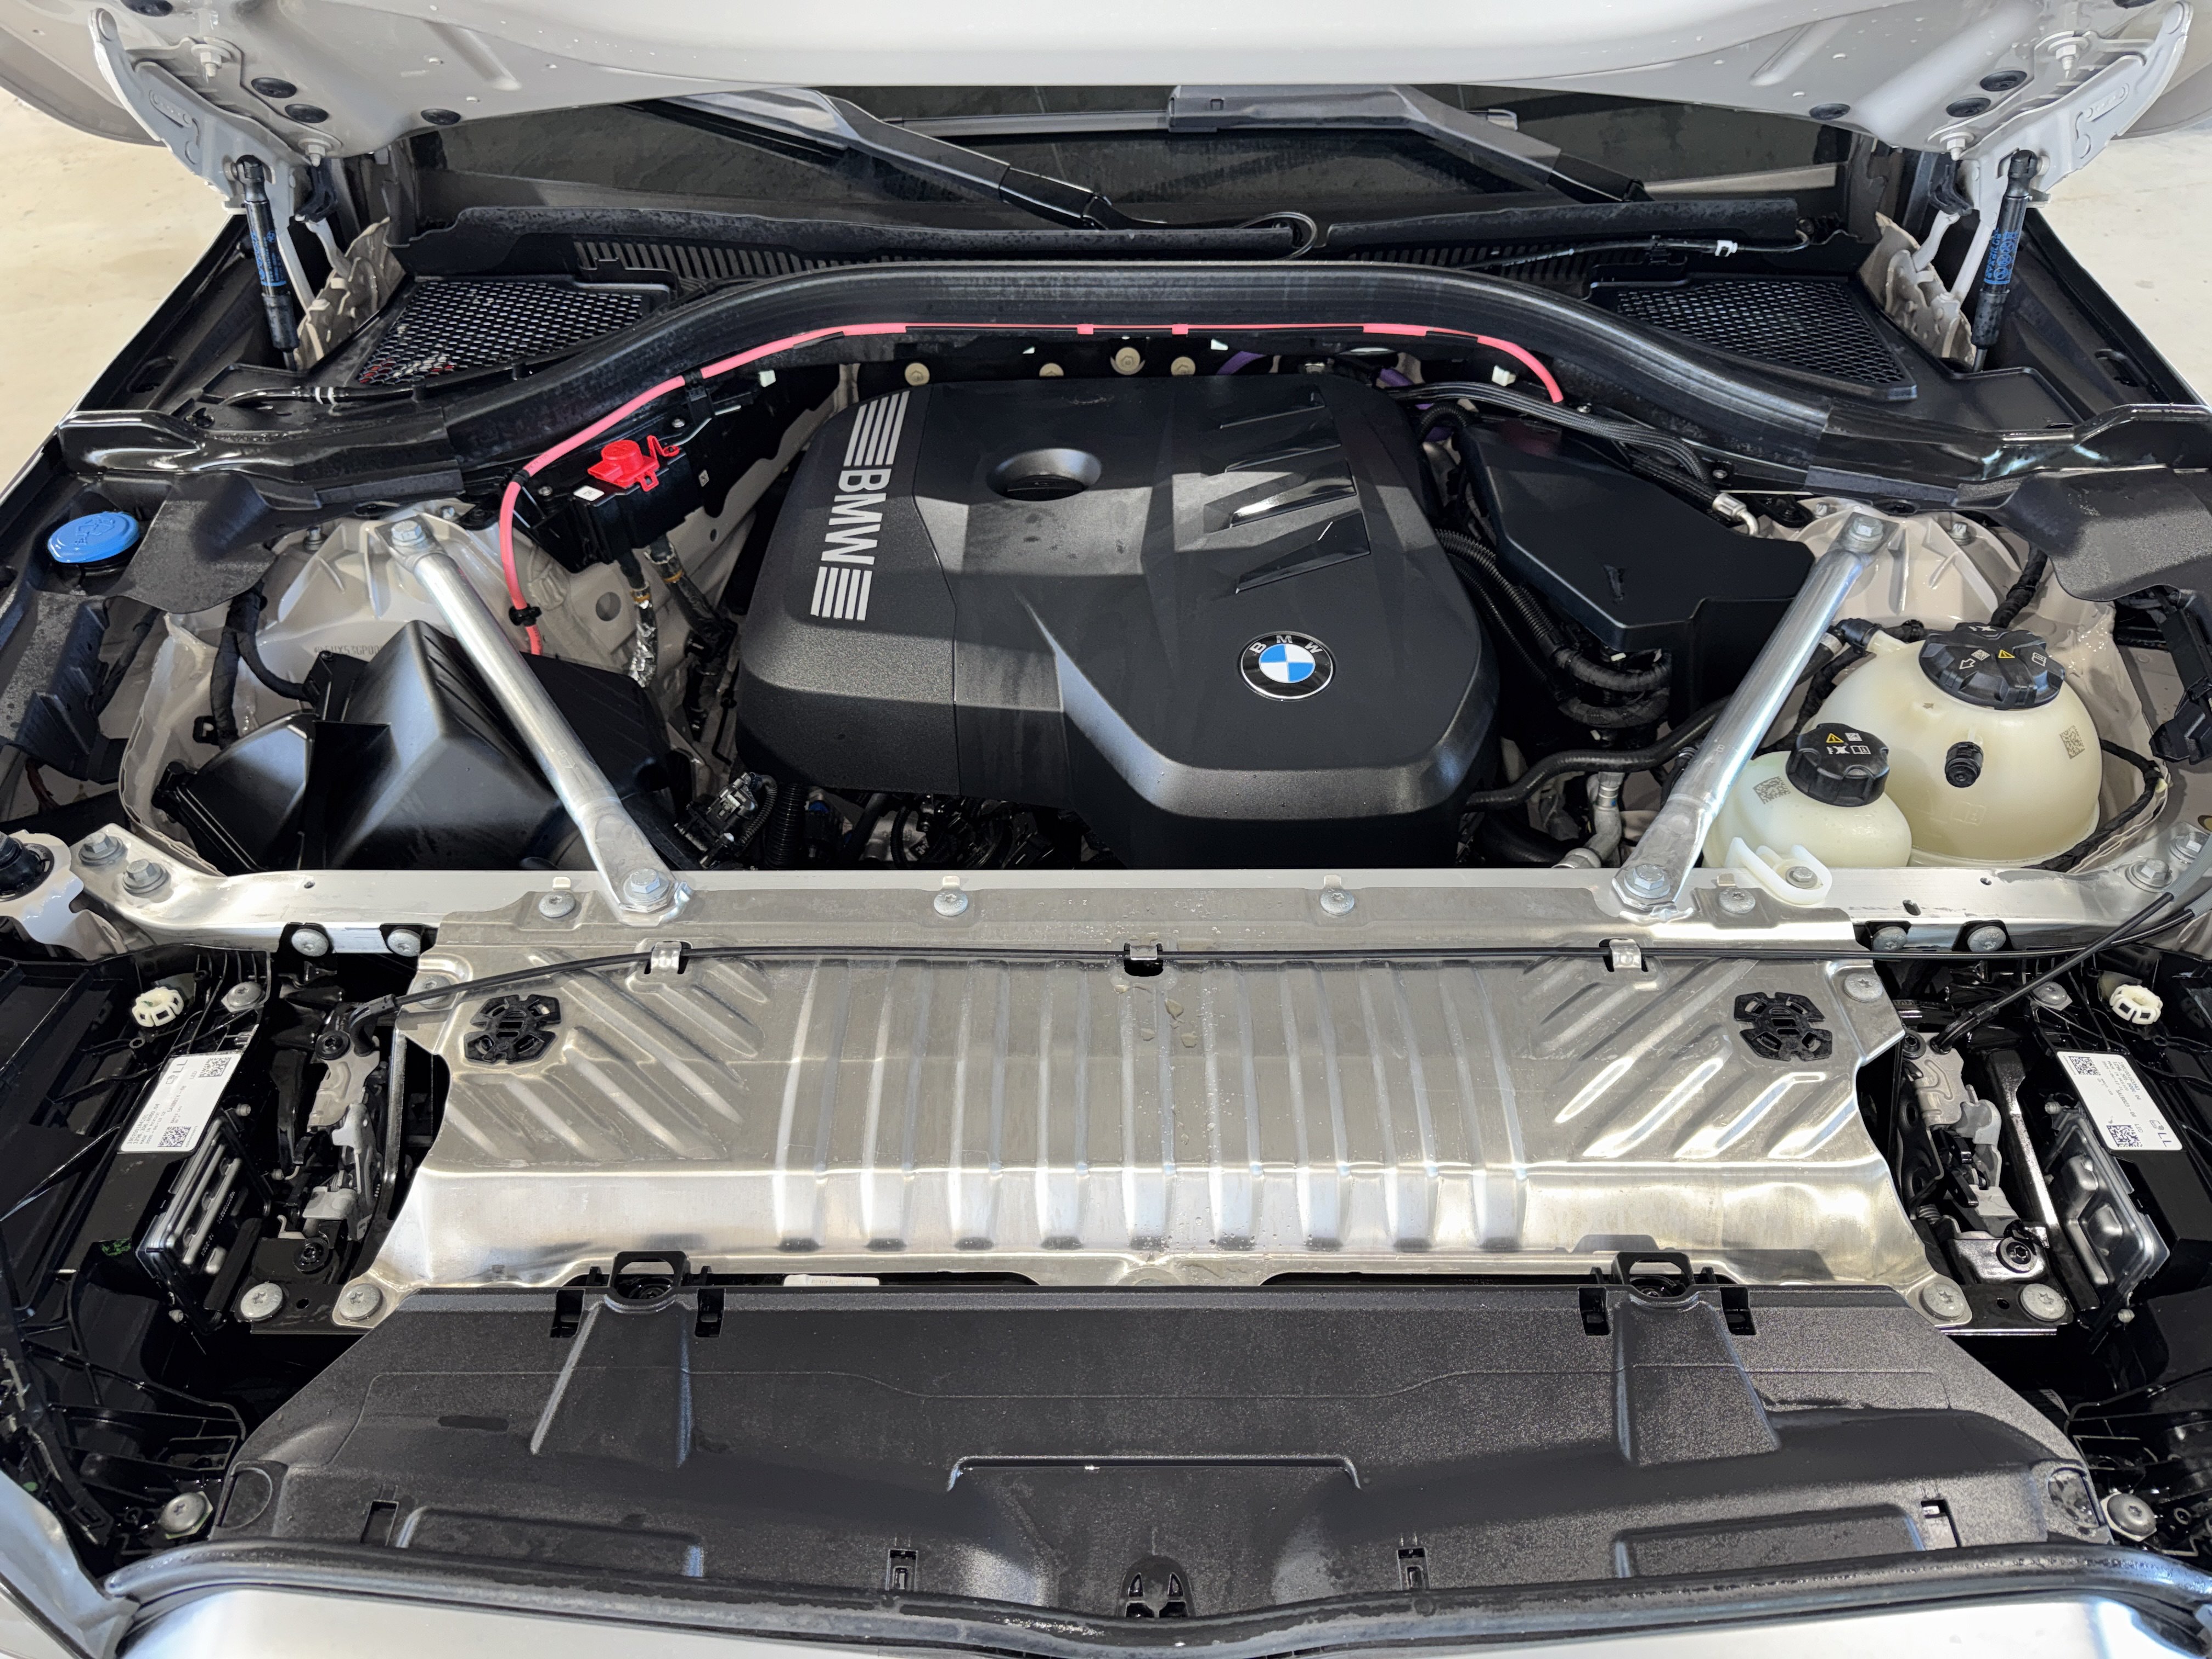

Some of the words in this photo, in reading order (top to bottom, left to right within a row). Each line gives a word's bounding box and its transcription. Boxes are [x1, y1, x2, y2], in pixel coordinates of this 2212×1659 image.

[821, 468, 892, 565] BMW
[1249, 633, 1323, 657] BMW
[172, 1059, 188, 1073] LL
[189, 1071, 198, 1079] LED
[2134, 1124, 2143, 1132] LED
[2157, 1132, 2172, 1147] LL
